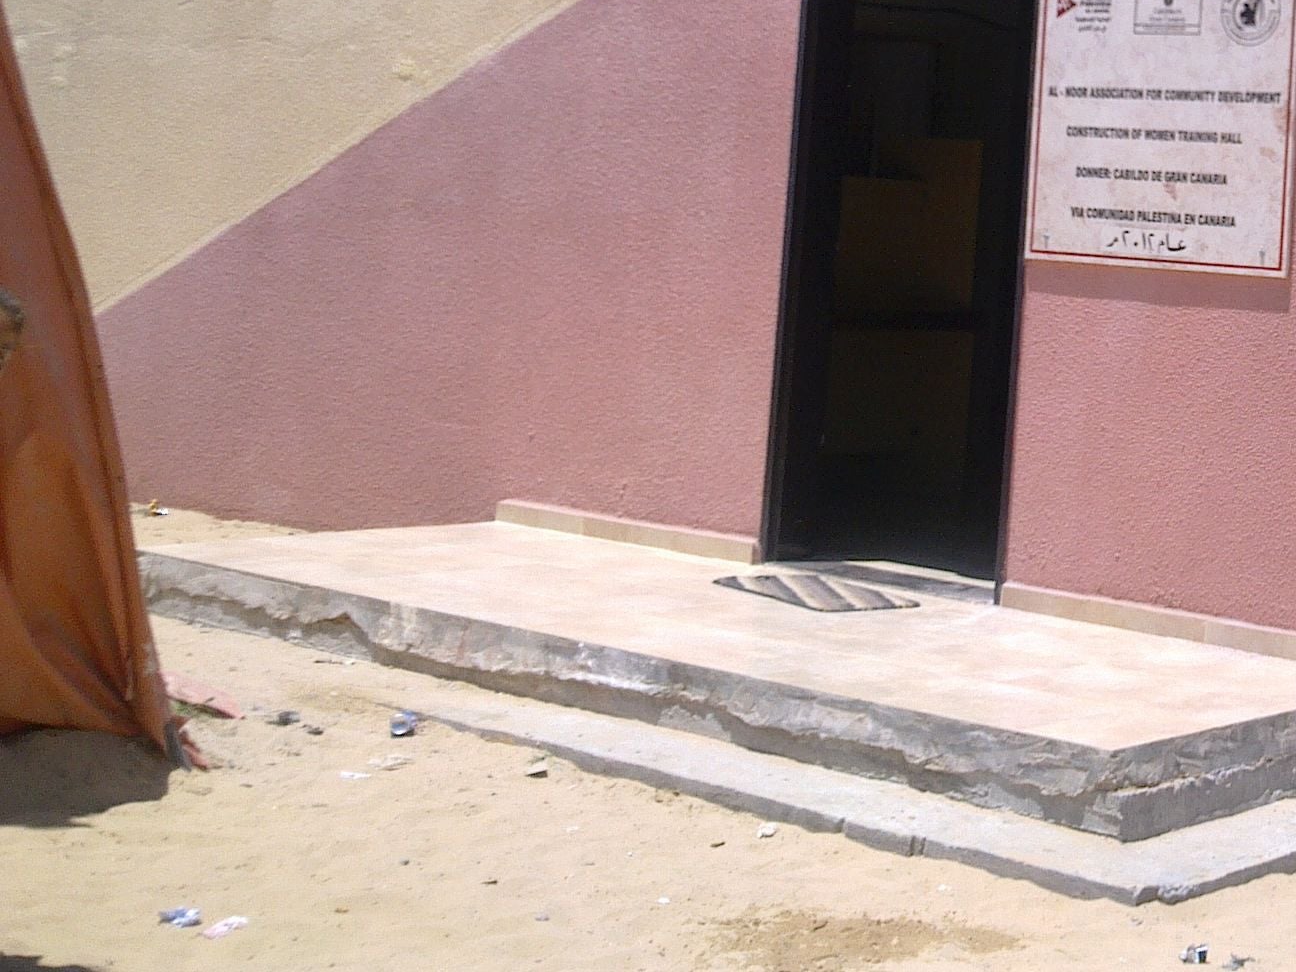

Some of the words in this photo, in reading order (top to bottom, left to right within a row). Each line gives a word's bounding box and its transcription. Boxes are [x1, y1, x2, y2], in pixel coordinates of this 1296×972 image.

[1048, 86, 1058, 97] AL
[1065, 86, 1087, 99] NOOR
[1089, 86, 1143, 100] ASSOCIATION
[1145, 88, 1162, 100] FOR
[1164, 89, 1216, 102] COMMUNITY
[1218, 90, 1281, 104] DEVELOPMENT
[1066, 125, 1129, 139] CONSTRUCTION
[1131, 128, 1142, 140] OF
[1144, 129, 1175, 141] WOMEN
[1177, 130, 1218, 143] TRAINING
[1220, 131, 1243, 144] HALL
[1076, 166, 1111, 179] DONNER:
[1113, 168, 1149, 182] CABILDO
[1151, 170, 1162, 182] DE
[1164, 170, 1188, 183] GRAN
[1190, 172, 1228, 185] CANARIA
[1070, 206, 1084, 218] VIA
[1086, 207, 1135, 221] COMUNIDAD
[1137, 210, 1182, 224] PALESTINA
[1184, 213, 1196, 225] EN
[1198, 215, 1236, 227] CANARIA
